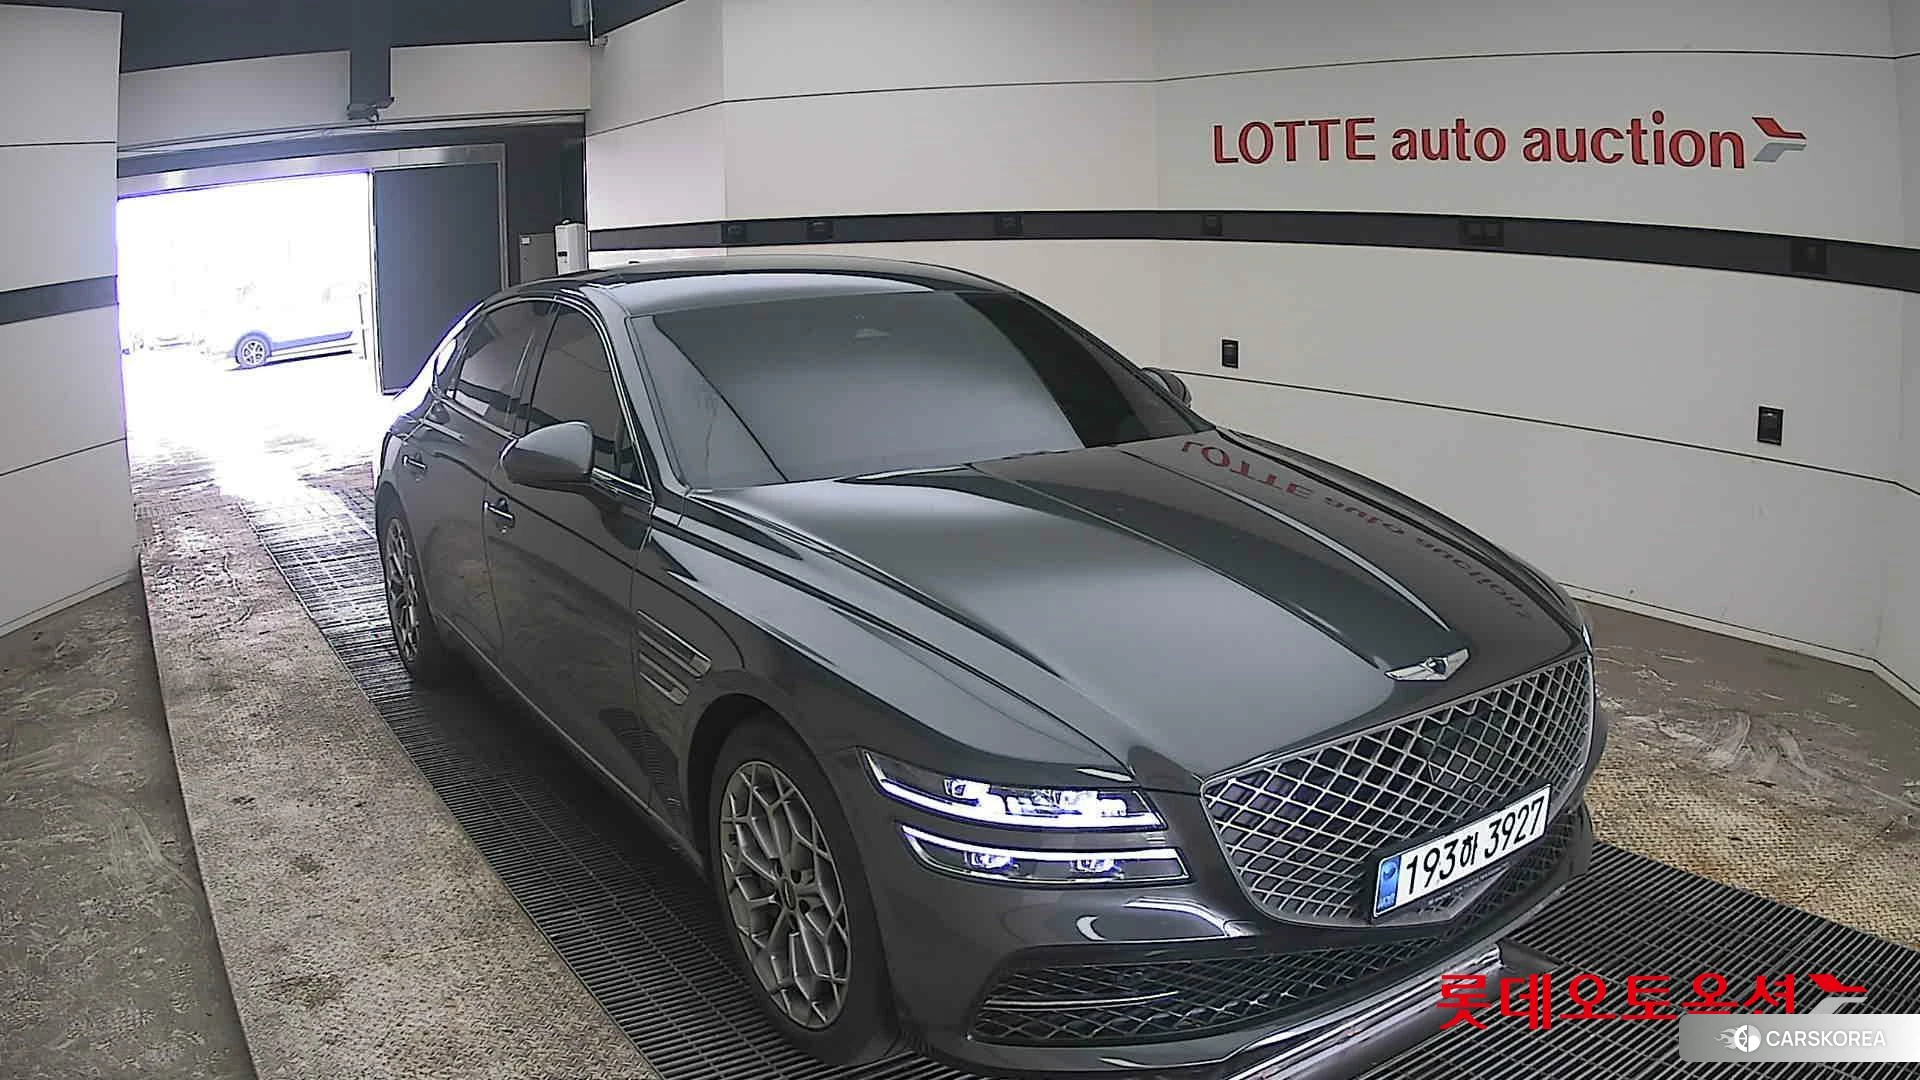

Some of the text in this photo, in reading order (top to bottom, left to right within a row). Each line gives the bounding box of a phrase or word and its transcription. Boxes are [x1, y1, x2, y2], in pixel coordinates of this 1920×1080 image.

[1212, 110, 1746, 169] LOTTE auto auction
[1406, 795, 1545, 895] 193하 3927
